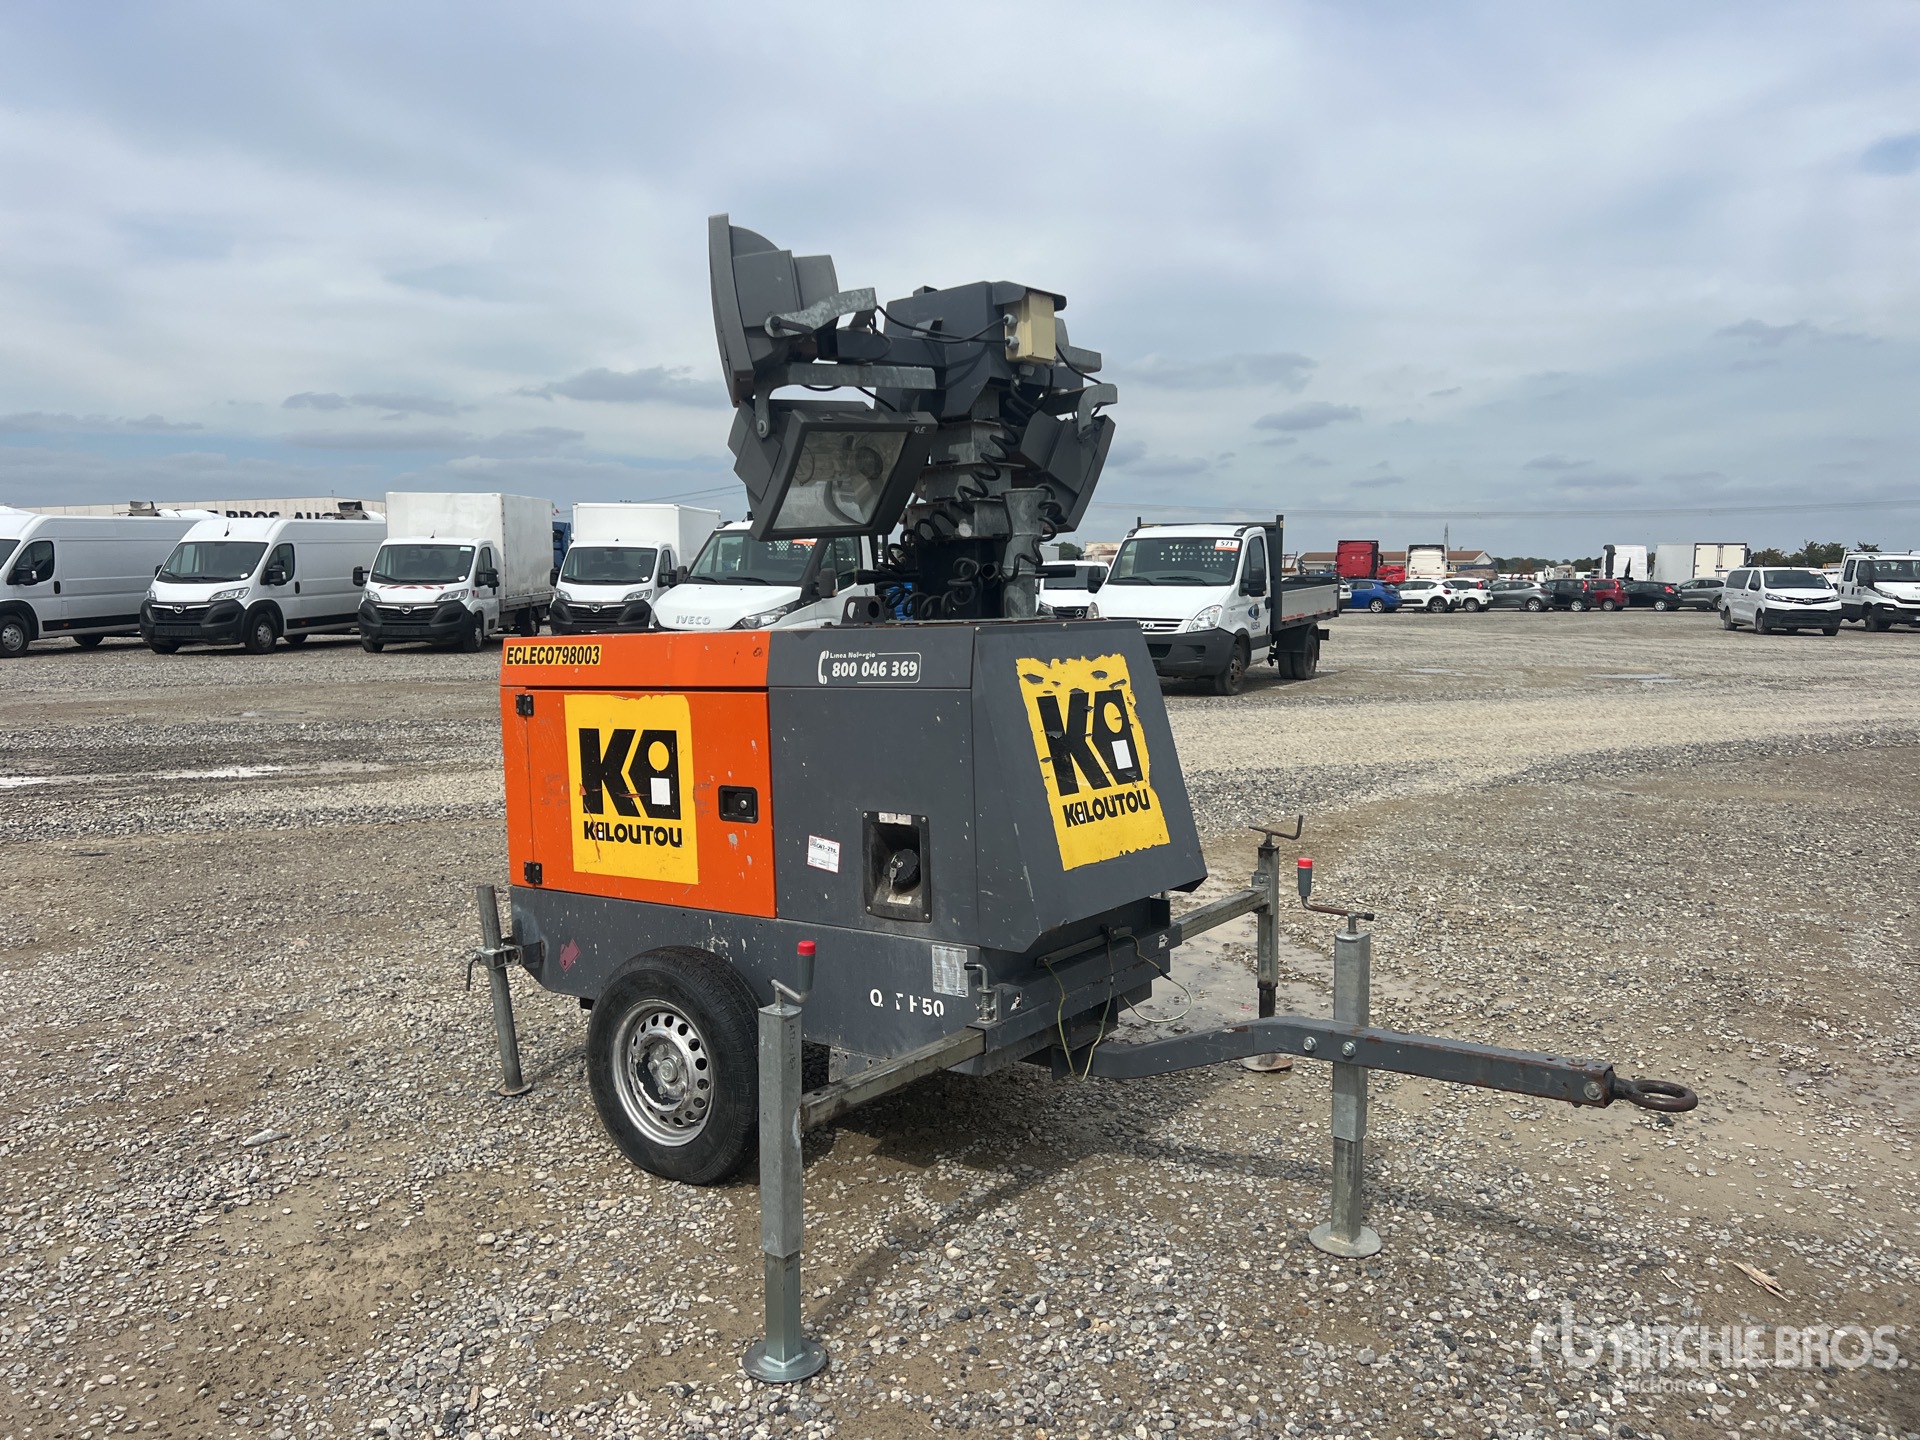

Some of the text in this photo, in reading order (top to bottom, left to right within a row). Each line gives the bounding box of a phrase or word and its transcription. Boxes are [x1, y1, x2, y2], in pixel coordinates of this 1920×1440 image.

[675, 615, 712, 626] IVECO
[832, 661, 918, 677] 800 046 369
